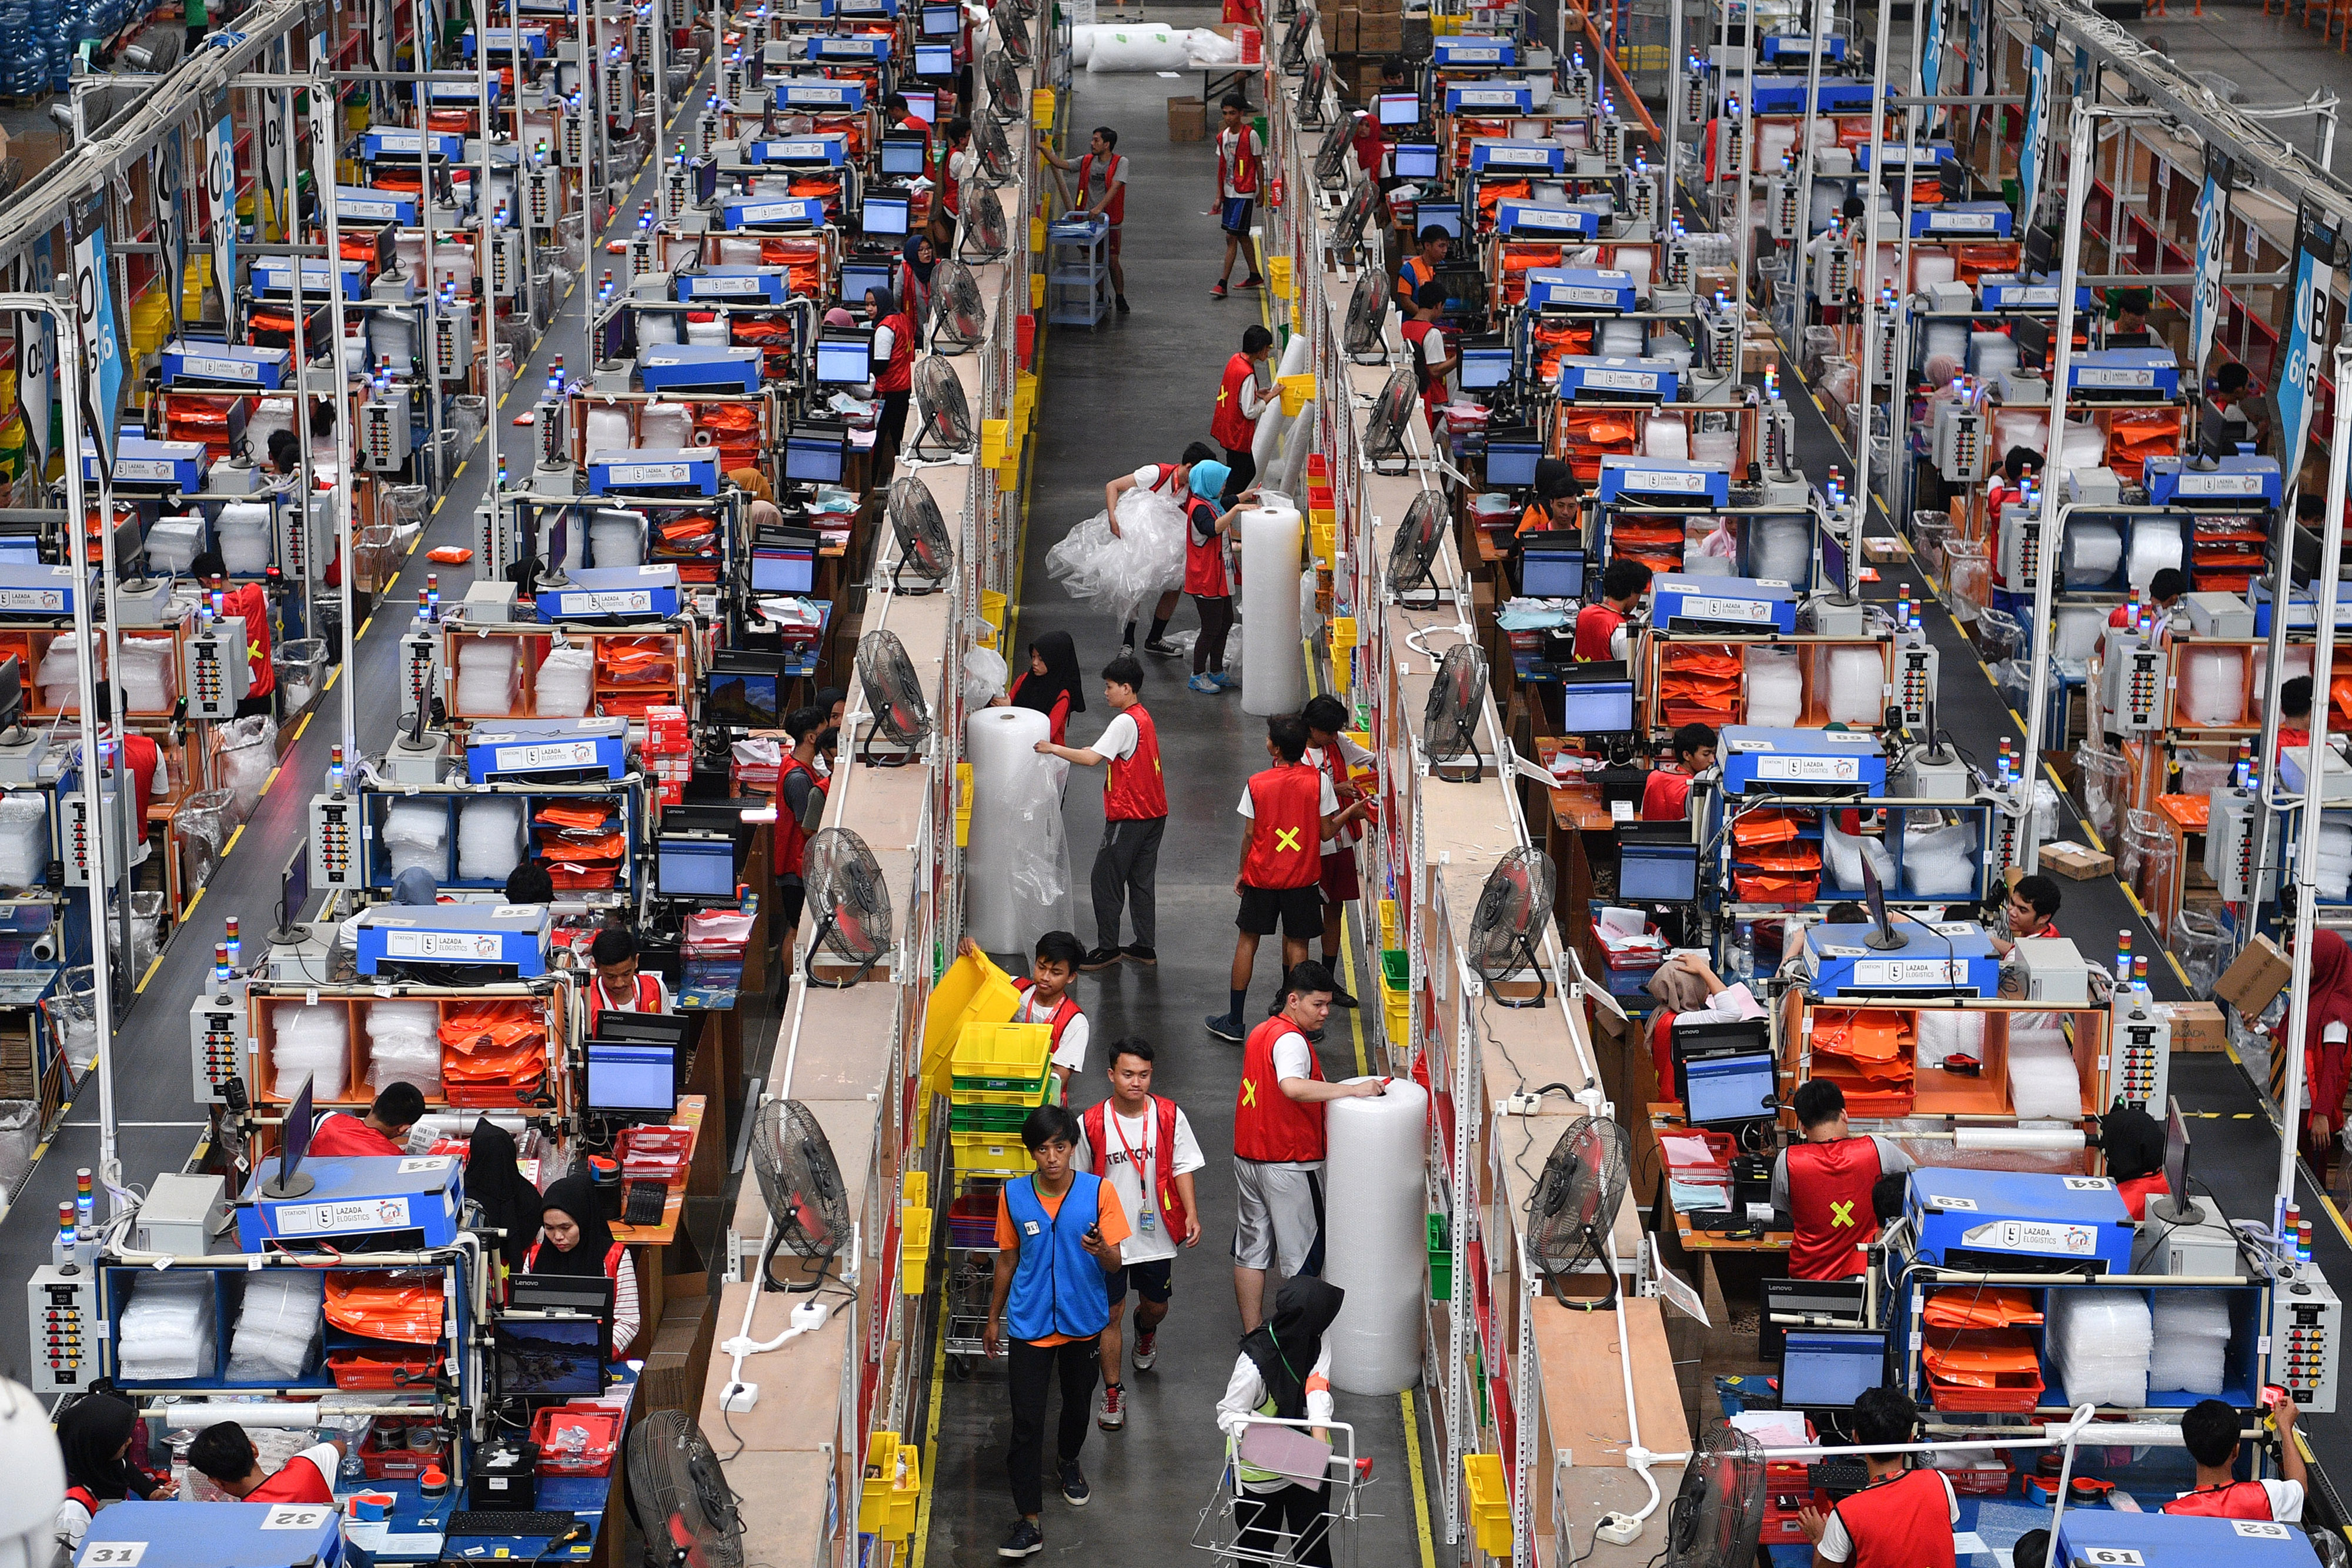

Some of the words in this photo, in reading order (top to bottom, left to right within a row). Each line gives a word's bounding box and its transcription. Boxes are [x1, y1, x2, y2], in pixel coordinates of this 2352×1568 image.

[408, 1161, 440, 1169] 34
[2070, 1180, 2104, 1188] 64
[1937, 1198, 1975, 1208] 63
[337, 1214, 369, 1222] ELOGISTICS
[2023, 1236, 2056, 1244] ELOGISTICS
[276, 1513, 316, 1524] 32
[2240, 1524, 2281, 1534] 62
[93, 1550, 132, 1562] 31
[2097, 1552, 2136, 1563] 61
